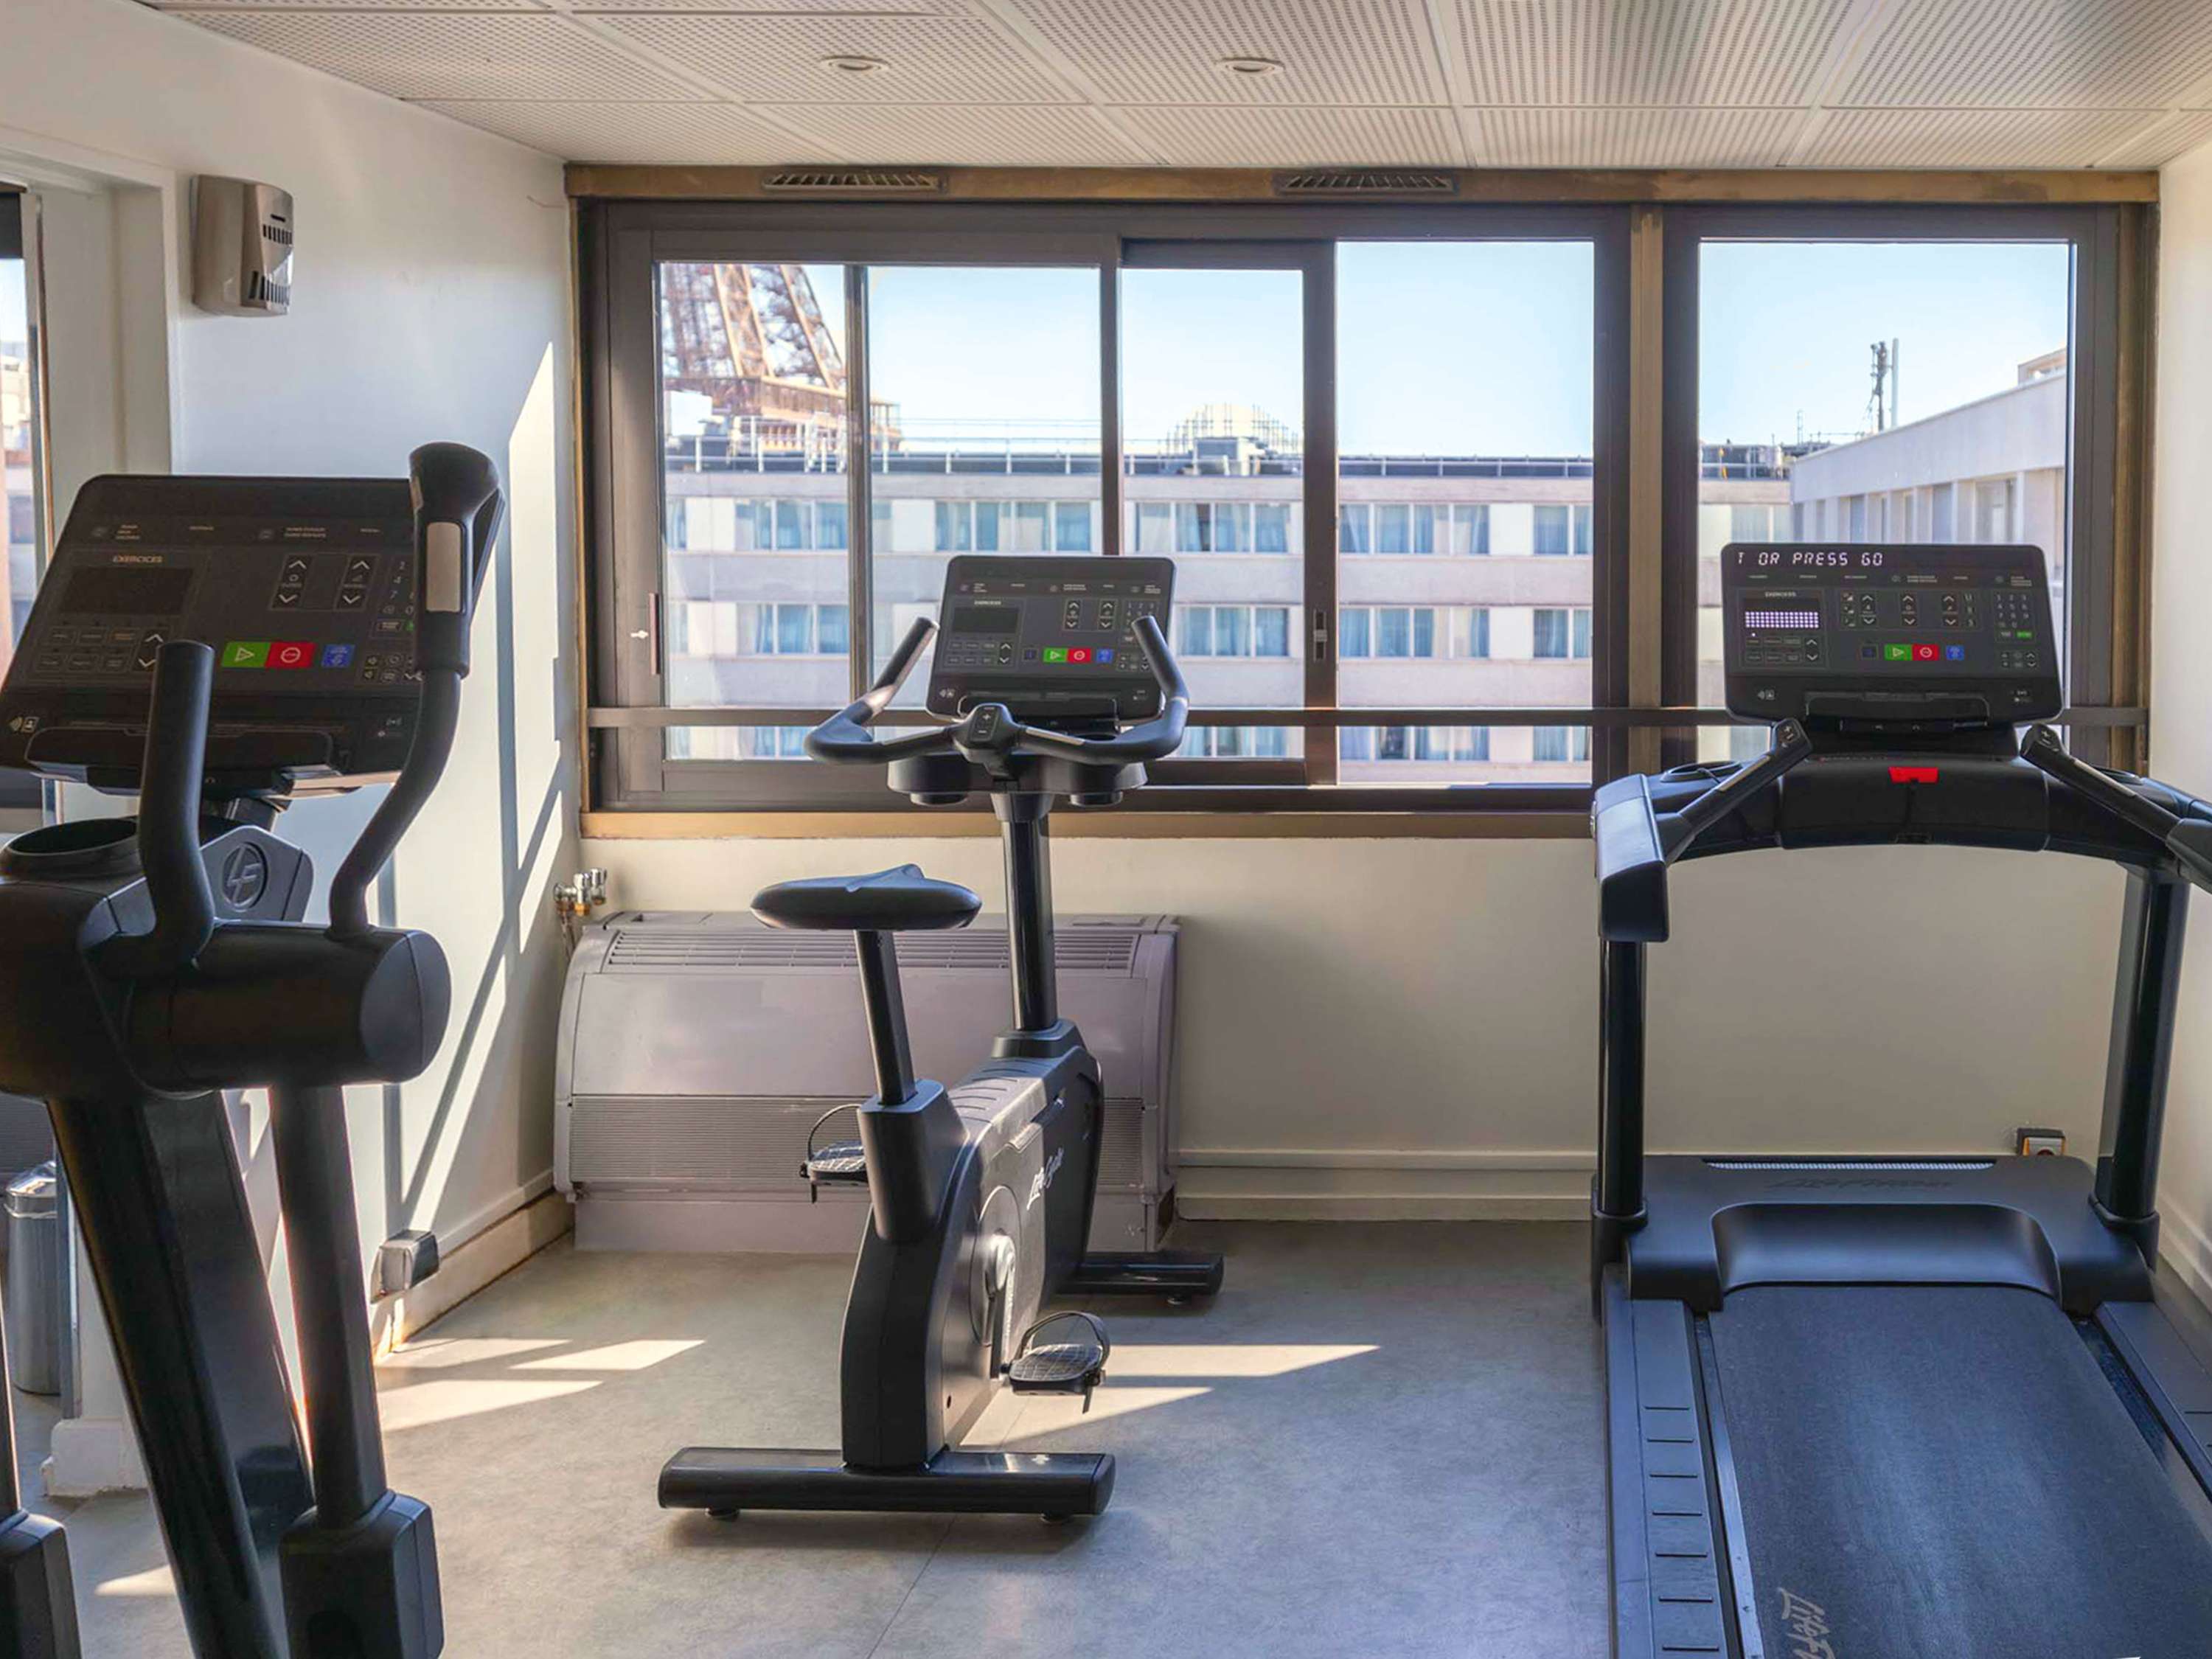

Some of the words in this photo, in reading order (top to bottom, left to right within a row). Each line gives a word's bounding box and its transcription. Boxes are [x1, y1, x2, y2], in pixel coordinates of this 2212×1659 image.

[1758, 552, 1781, 566] OR
[1792, 552, 1848, 566] PRESS
[1860, 552, 1884, 566] GO
